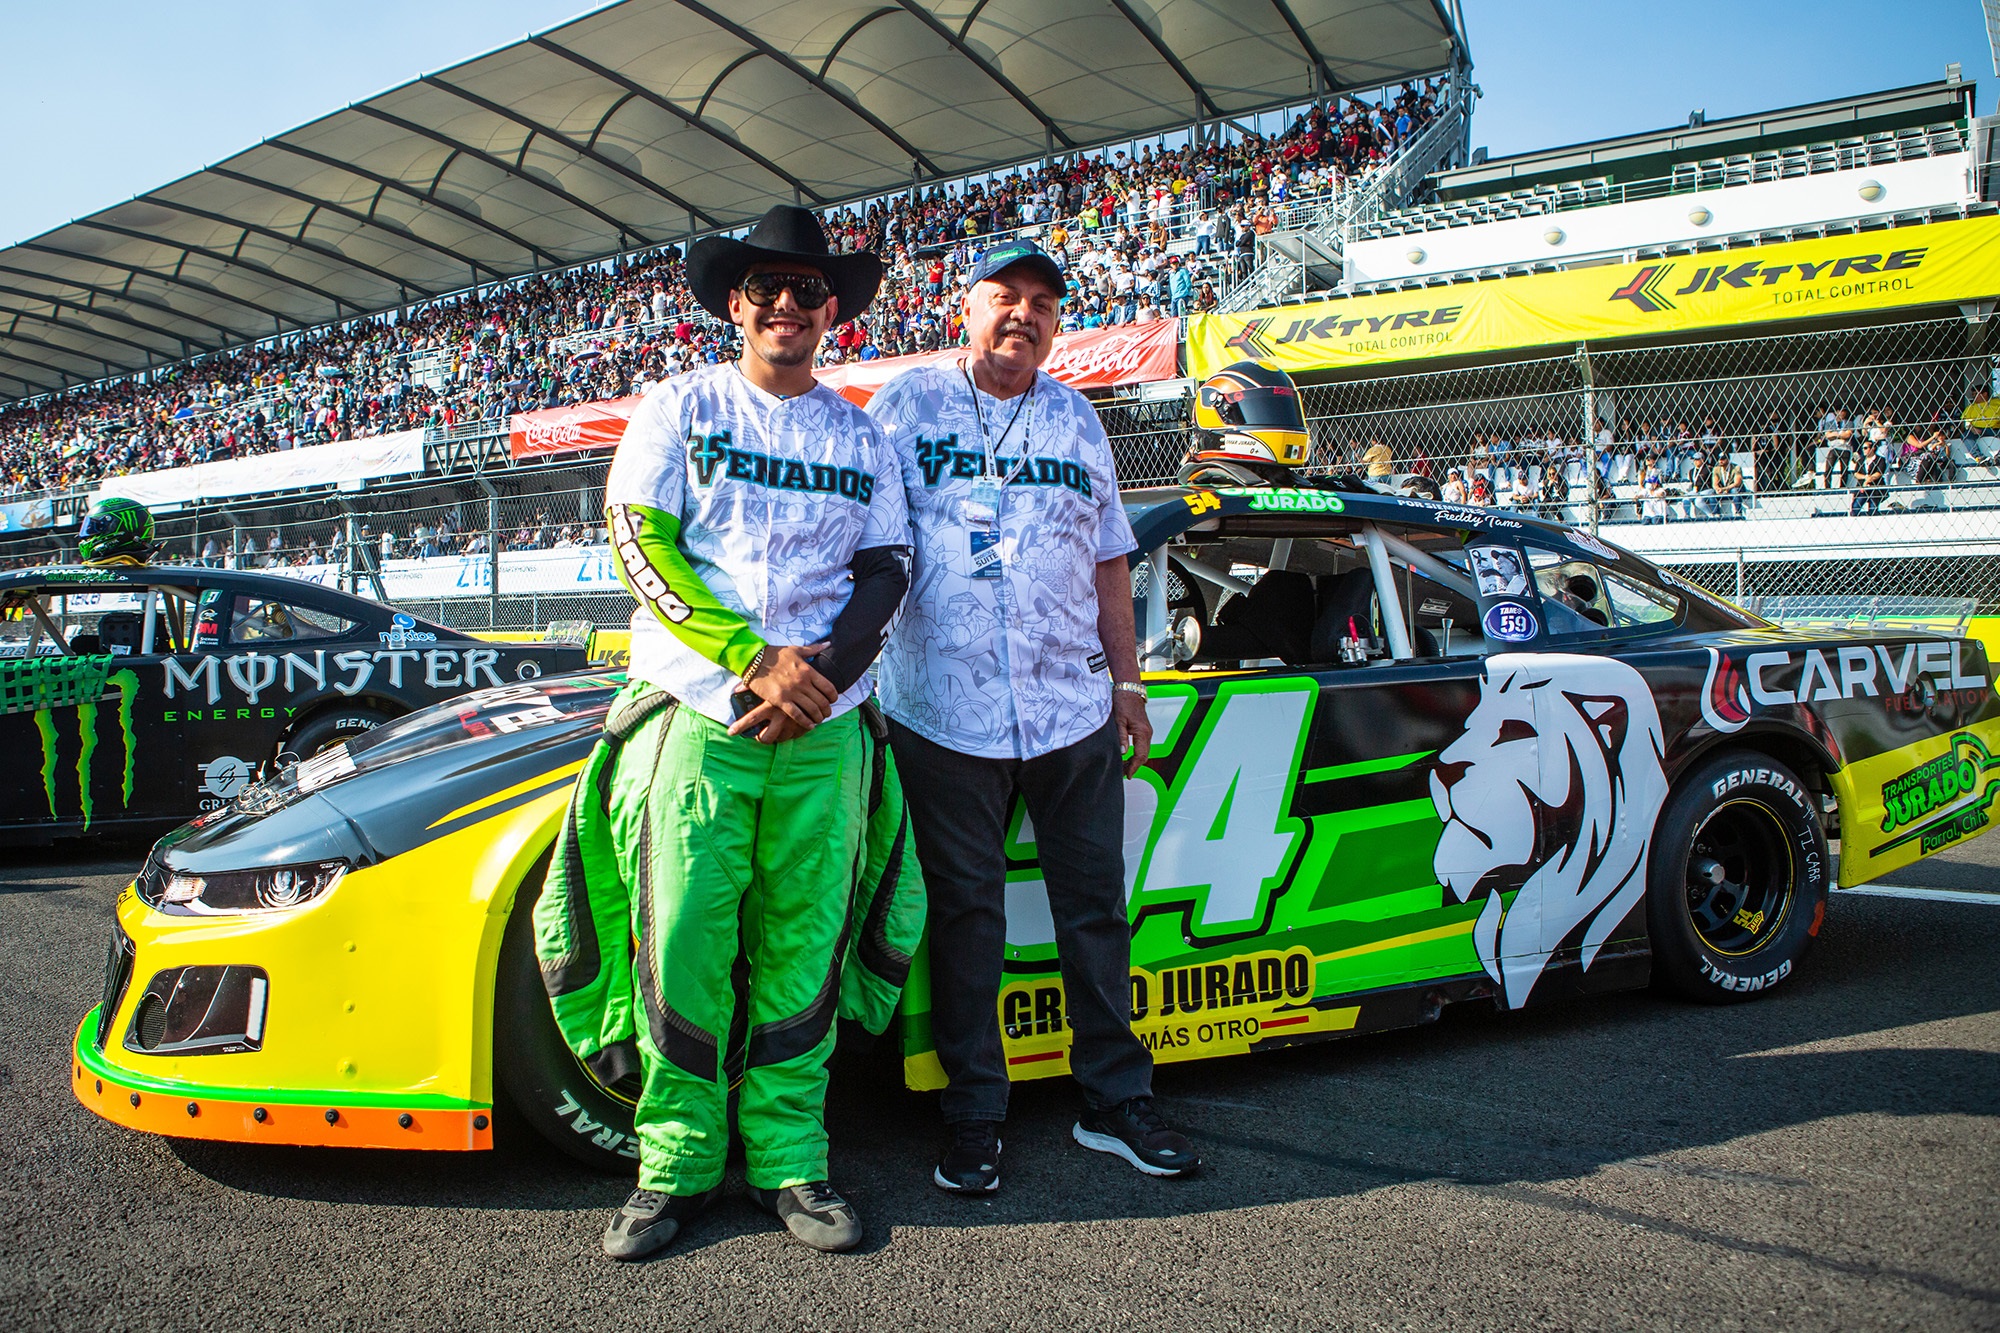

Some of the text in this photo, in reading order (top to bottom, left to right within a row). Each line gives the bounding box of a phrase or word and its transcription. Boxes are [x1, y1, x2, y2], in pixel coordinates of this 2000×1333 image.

[1773, 277, 1914, 305] TOTAL CONTROL
[1348, 331, 1453, 353] TOTAL CONTROL
[687, 429, 876, 507] VENADOS
[916, 432, 1093, 500] VENADOS
[1183, 490, 1222, 516] 54
[1251, 495, 1345, 512] JURADO
[1396, 499, 1424, 508] POR
[1434, 510, 1523, 528] Freddy Tame
[975, 552, 999, 568] SUITE
[379, 628, 437, 645] noktos
[1500, 615, 1527, 633] 59
[161, 648, 503, 706] MONSTER
[1746, 640, 1986, 706] CARVEL
[164, 707, 297, 722] ENERGY
[1885, 695, 1922, 713] FUEL
[1711, 768, 1805, 808] GENERAL
[1883, 754, 1954, 800] TRANSPORTES
[1881, 758, 1976, 833] JURADO
[1923, 826, 1961, 852] Parral,
[1732, 908, 1754, 928] 54
[1160, 952, 1310, 1018] JURADO
[1700, 954, 1792, 993] GENERAL
[1197, 1016, 1260, 1044] OTRO
